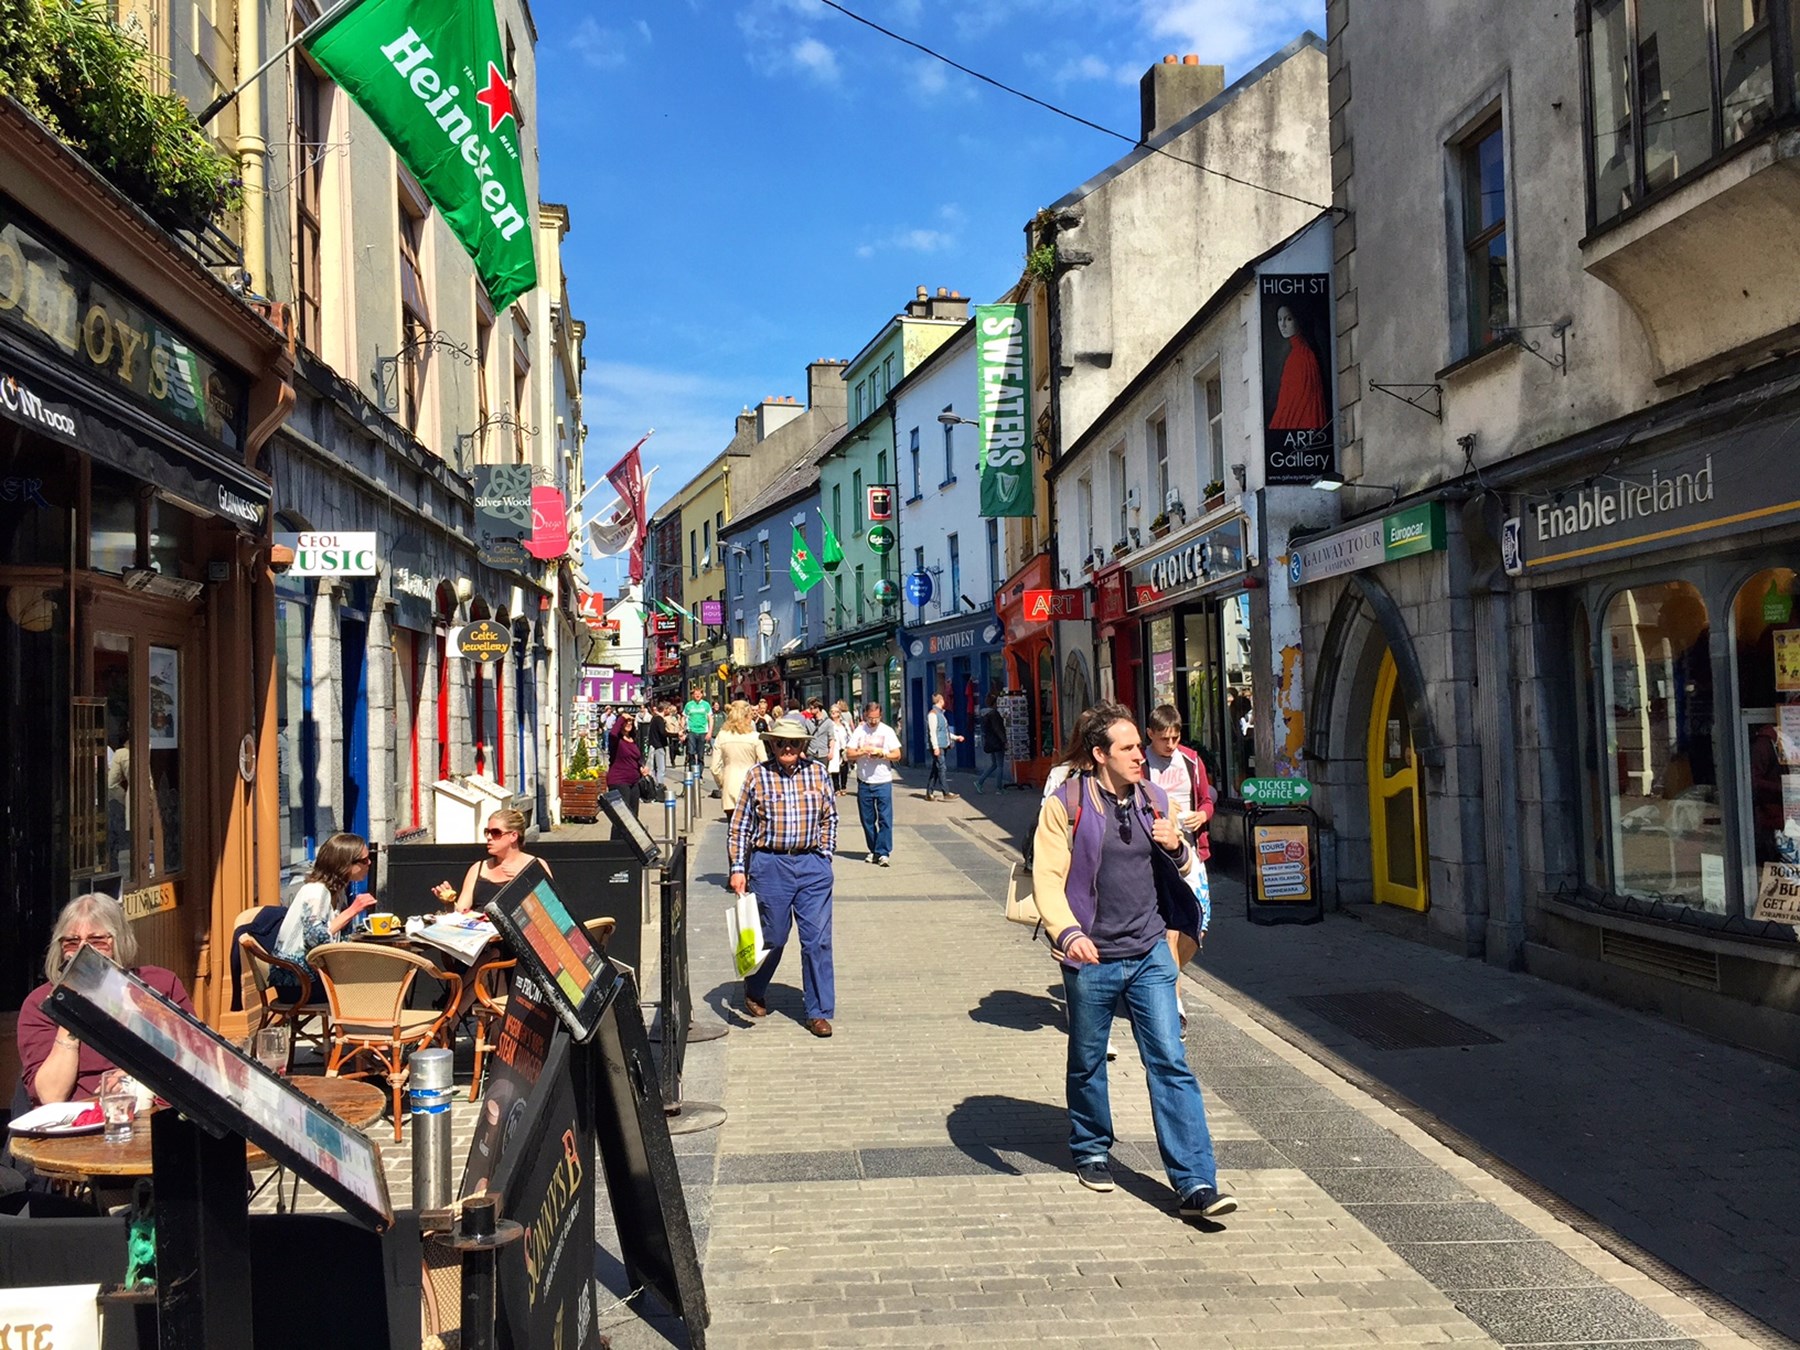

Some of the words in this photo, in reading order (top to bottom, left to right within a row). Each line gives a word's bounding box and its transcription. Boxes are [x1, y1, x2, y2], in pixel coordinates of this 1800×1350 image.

[380, 26, 525, 241] Heineken
[500, 135, 518, 160] MARK
[1263, 279, 1305, 294] HIGH
[1310, 278, 1326, 294] ST
[982, 316, 1026, 467] SWEATERS
[44, 409, 76, 438] DOOR
[1283, 431, 1314, 446] ART
[1270, 451, 1330, 470] Gallery
[218, 484, 258, 523] GUINNESS
[475, 496, 502, 507] Silver
[502, 496, 531, 507] Wood
[298, 534, 340, 547] CEOL
[1391, 522, 1424, 542] Europcar
[1304, 541, 1346, 568] GALWAY
[1346, 531, 1381, 557] TOUR
[290, 550, 374, 572] USIC
[1150, 543, 1203, 593] CHOICE
[1032, 594, 1075, 615] ART
[470, 631, 498, 640] Celtic
[461, 642, 509, 652] Jewellery
[1258, 781, 1293, 790] TICKET
[1258, 790, 1293, 799] OFFICE
[1261, 843, 1285, 851] TOURS
[125, 888, 170, 915] UINNESS
[1763, 898, 1787, 911] GET
